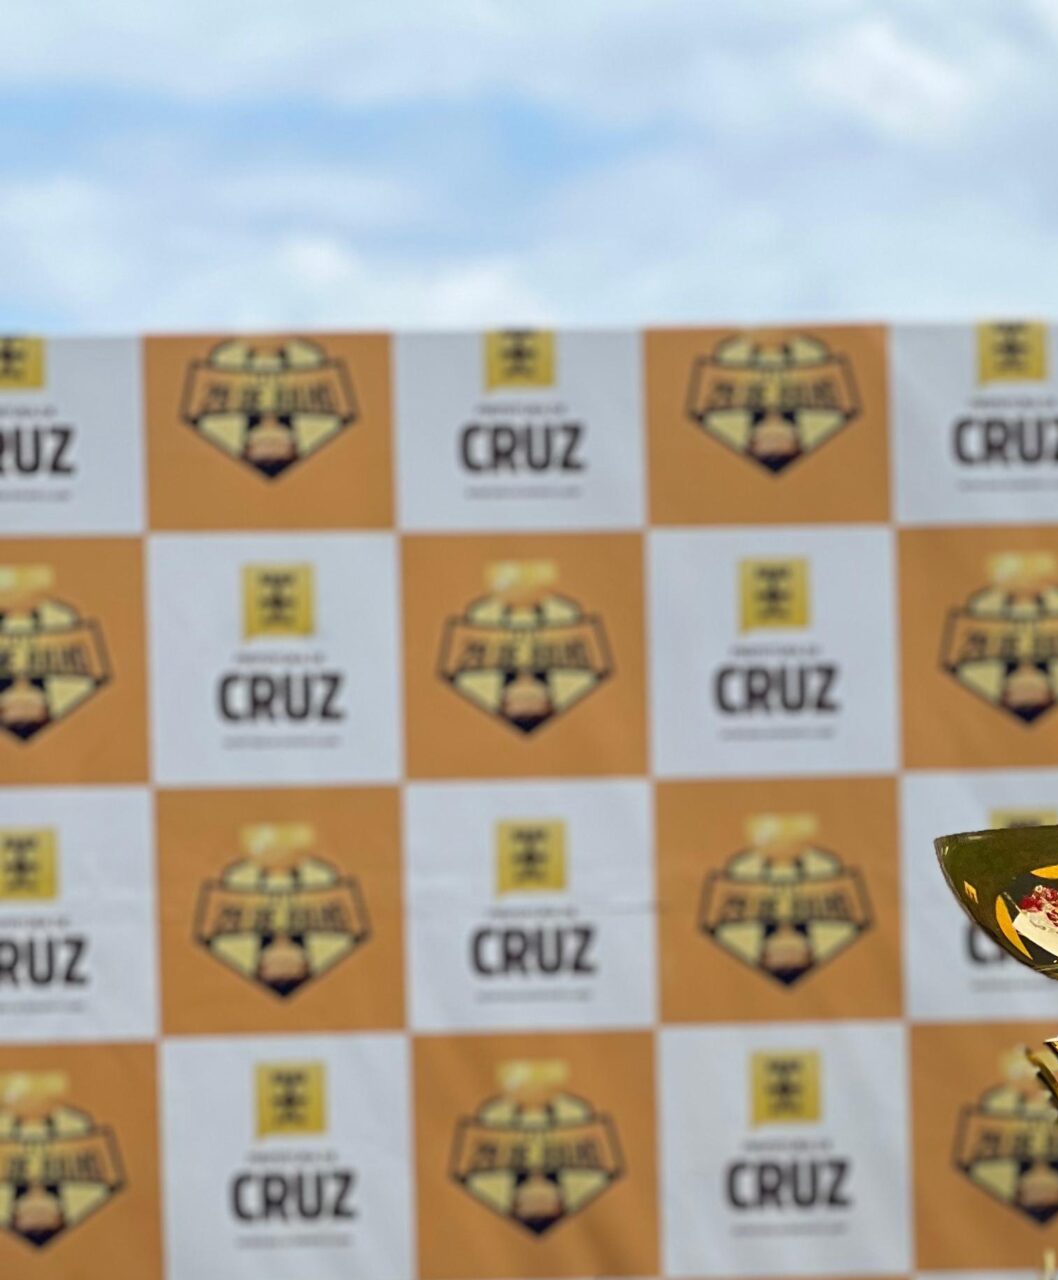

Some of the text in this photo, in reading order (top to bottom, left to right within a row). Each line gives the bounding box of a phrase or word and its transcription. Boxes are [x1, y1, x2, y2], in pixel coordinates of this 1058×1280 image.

[0, 425, 76, 477] UZ
[458, 422, 585, 474] CRUZ
[216, 671, 344, 724] CRUZ
[712, 663, 838, 716] CRUZ
[469, 924, 596, 978] CRUZ
[230, 1169, 357, 1224] CRUZ
[724, 1158, 852, 1212] CRUZ
